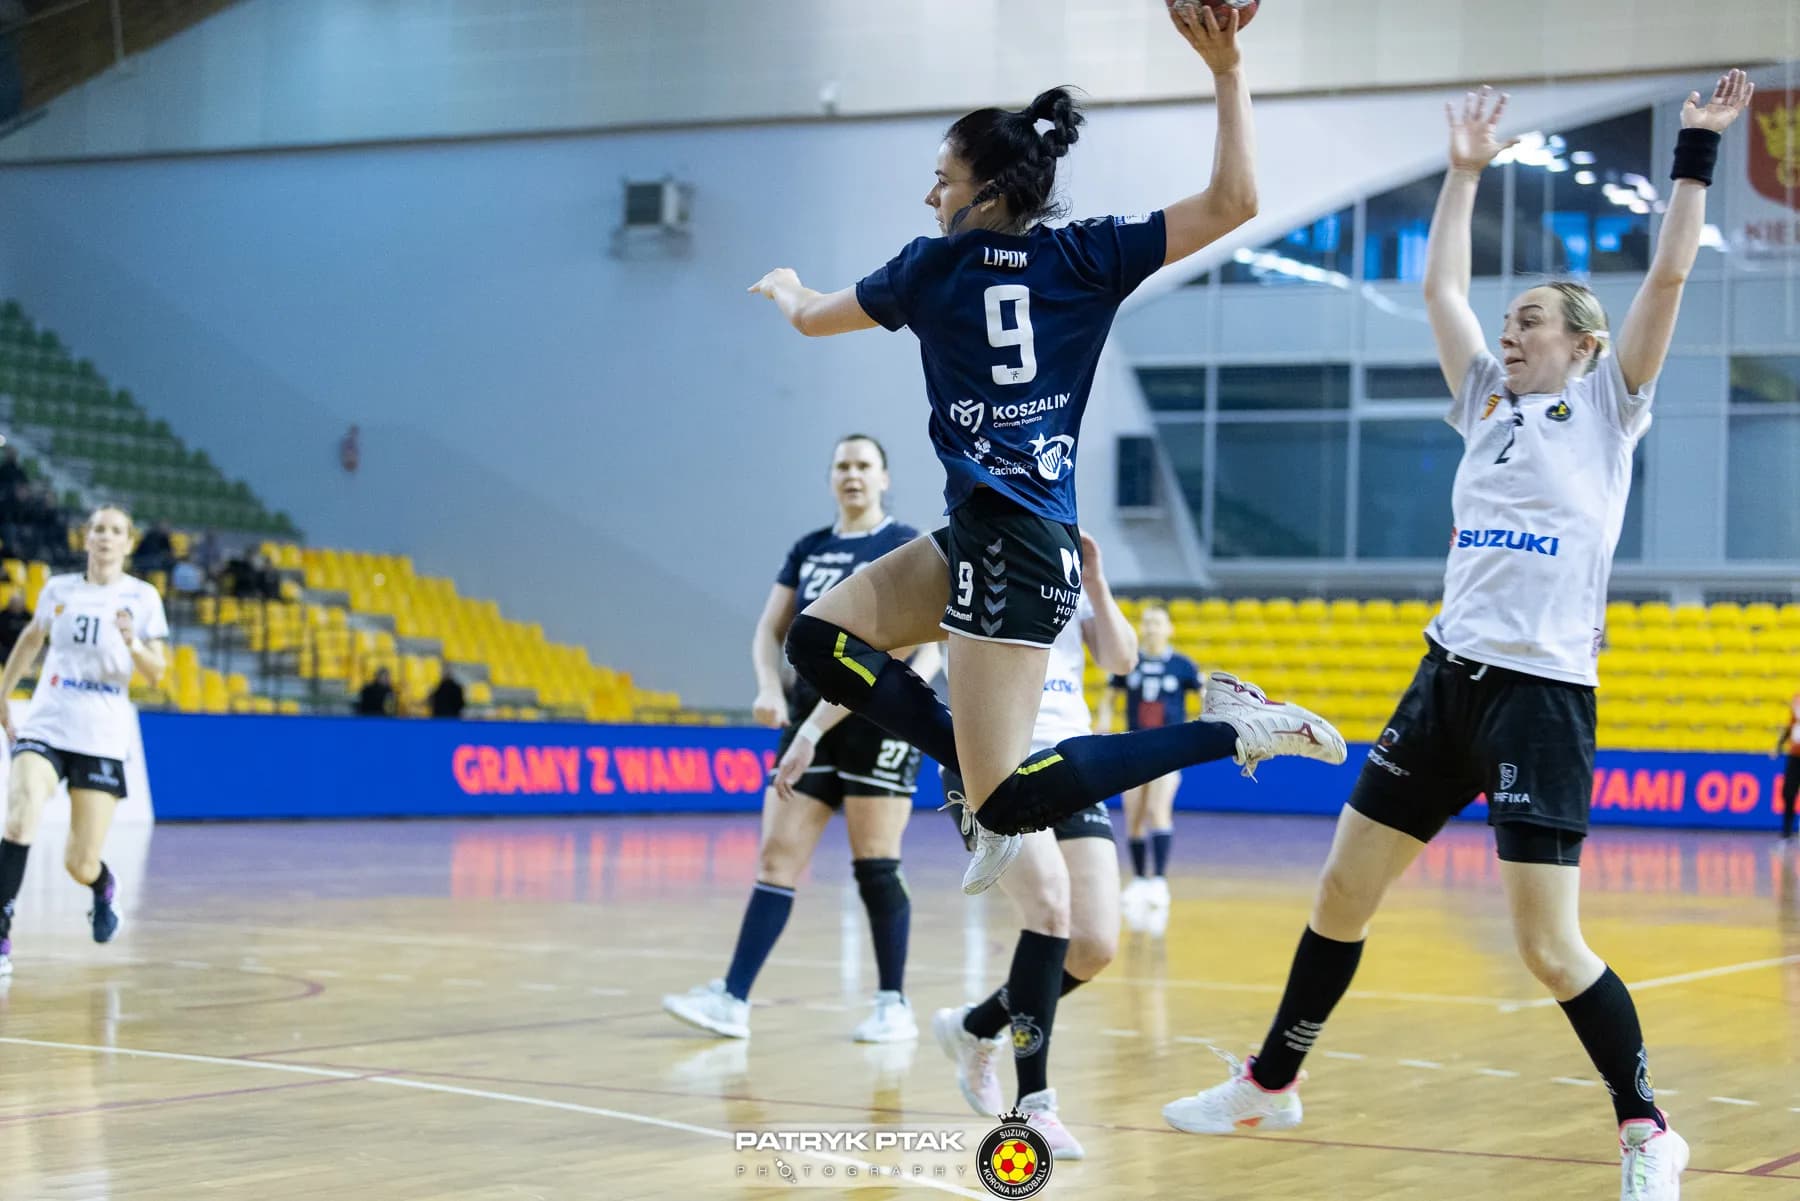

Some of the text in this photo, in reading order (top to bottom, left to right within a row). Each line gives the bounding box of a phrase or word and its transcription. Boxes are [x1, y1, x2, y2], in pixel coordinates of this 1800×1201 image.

[984, 246, 1028, 268] LIPOK
[983, 284, 1037, 386] 9
[992, 393, 1071, 420] KOSZALIN
[993, 420, 1021, 429] Centrum
[1494, 413, 1524, 465] 2
[1457, 529, 1559, 557] SUZUKI
[804, 568, 844, 600] 27
[957, 561, 974, 607] 9
[73, 615, 100, 645] 31
[452, 745, 580, 795] GRAMY
[586, 746, 615, 794] Z
[613, 746, 714, 794] WAMI
[714, 748, 763, 793] OD
[876, 738, 910, 770] 27
[1695, 770, 1761, 814] OD
